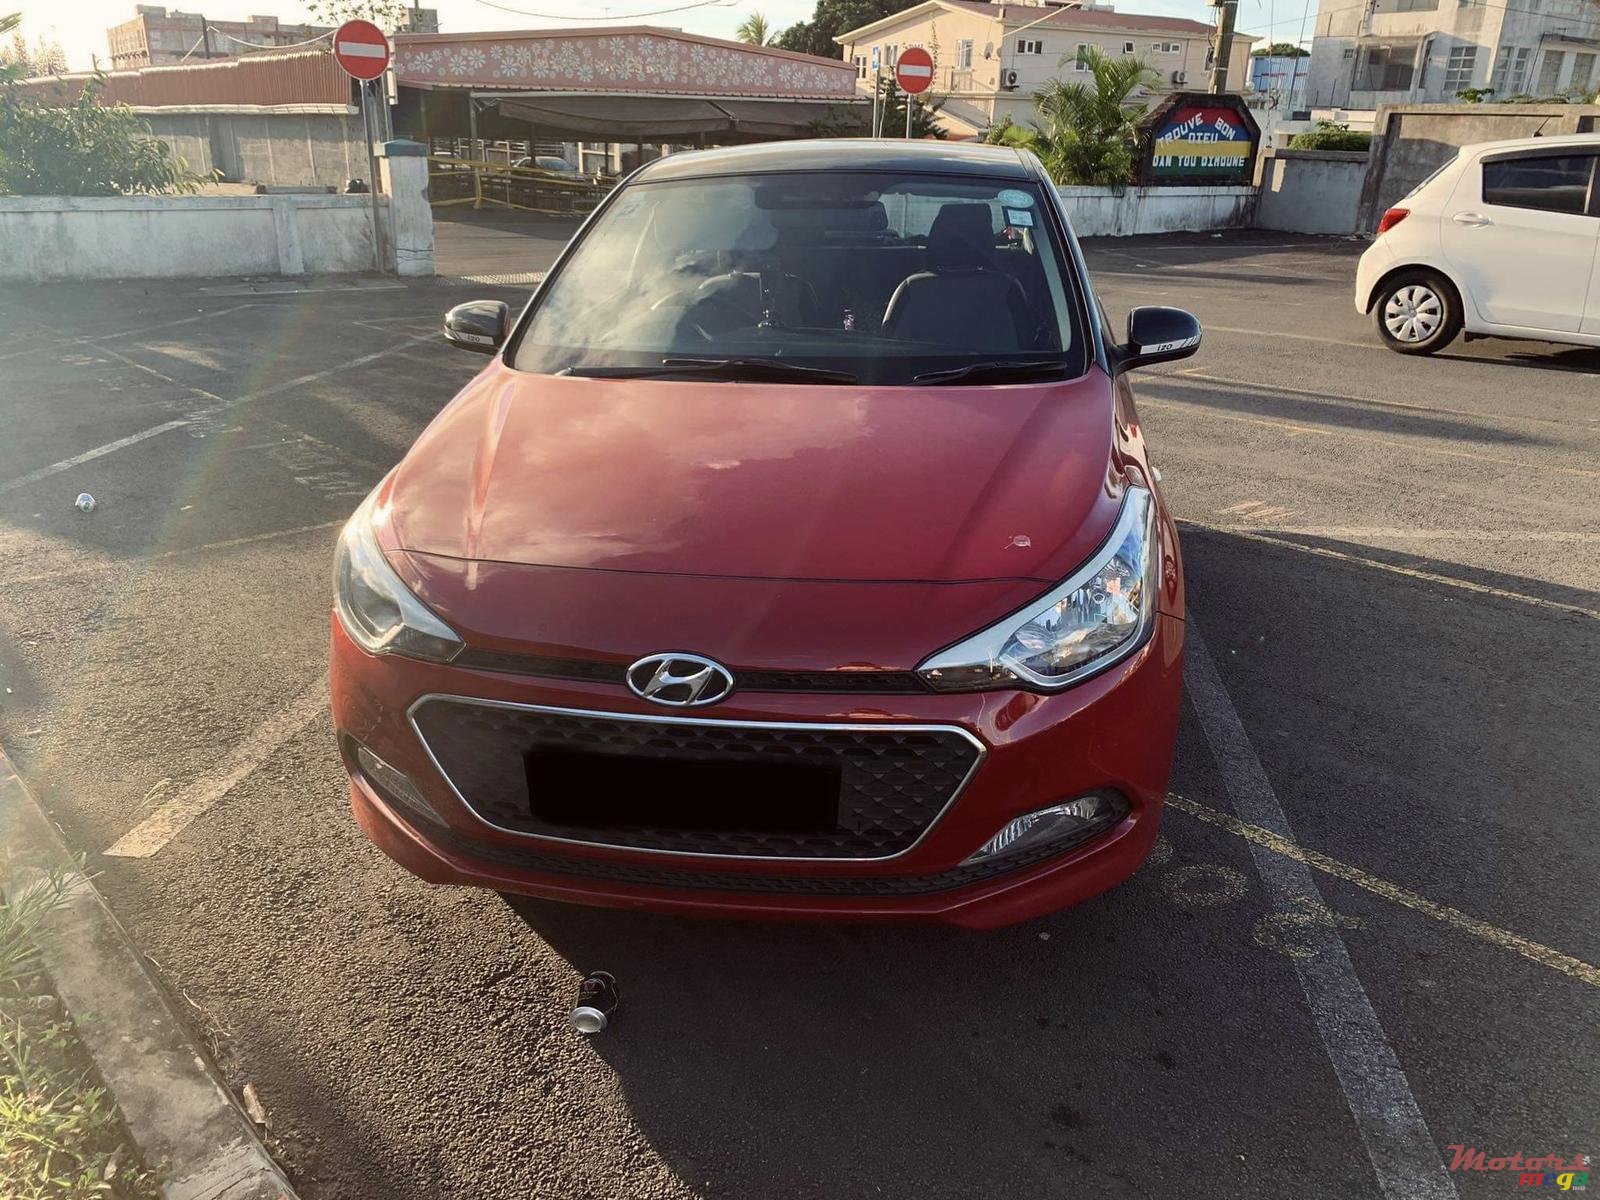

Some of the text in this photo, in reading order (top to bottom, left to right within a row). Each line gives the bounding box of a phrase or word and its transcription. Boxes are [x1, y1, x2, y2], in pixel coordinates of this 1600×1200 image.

[1155, 112, 1236, 147] TROUVE BON
[1188, 132, 1218, 144] DIEU
